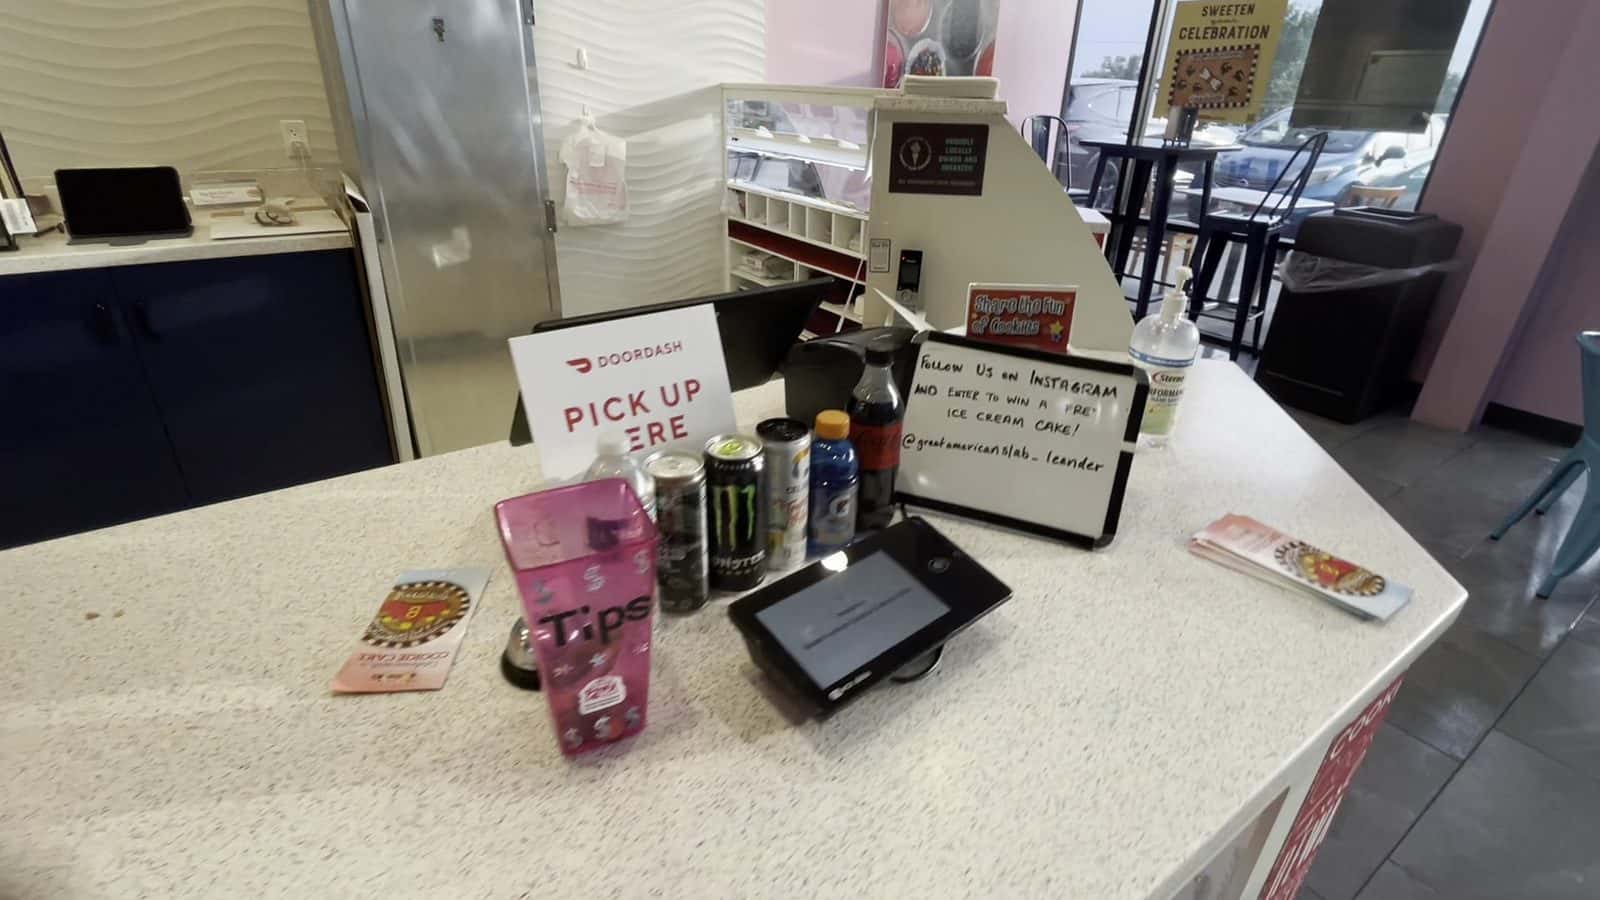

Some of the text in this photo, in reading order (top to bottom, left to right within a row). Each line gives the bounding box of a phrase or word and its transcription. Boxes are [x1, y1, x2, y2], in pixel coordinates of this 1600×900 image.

[1201, 3, 1256, 17] SWEETEN
[1178, 25, 1271, 41] CELEBRATION
[597, 340, 683, 368] DOORDASH
[976, 363, 994, 378] US
[1030, 369, 1118, 398] INSTAGRAM
[563, 378, 702, 432] PICK UP
[914, 383, 938, 396] AND
[948, 386, 980, 402] ENTER
[986, 392, 1000, 402] TO
[1006, 395, 1030, 407] WIN
[1039, 400, 1049, 409] A
[947, 408, 1081, 437] ICE CREAM CAKE!
[537, 595, 653, 648] Tips
